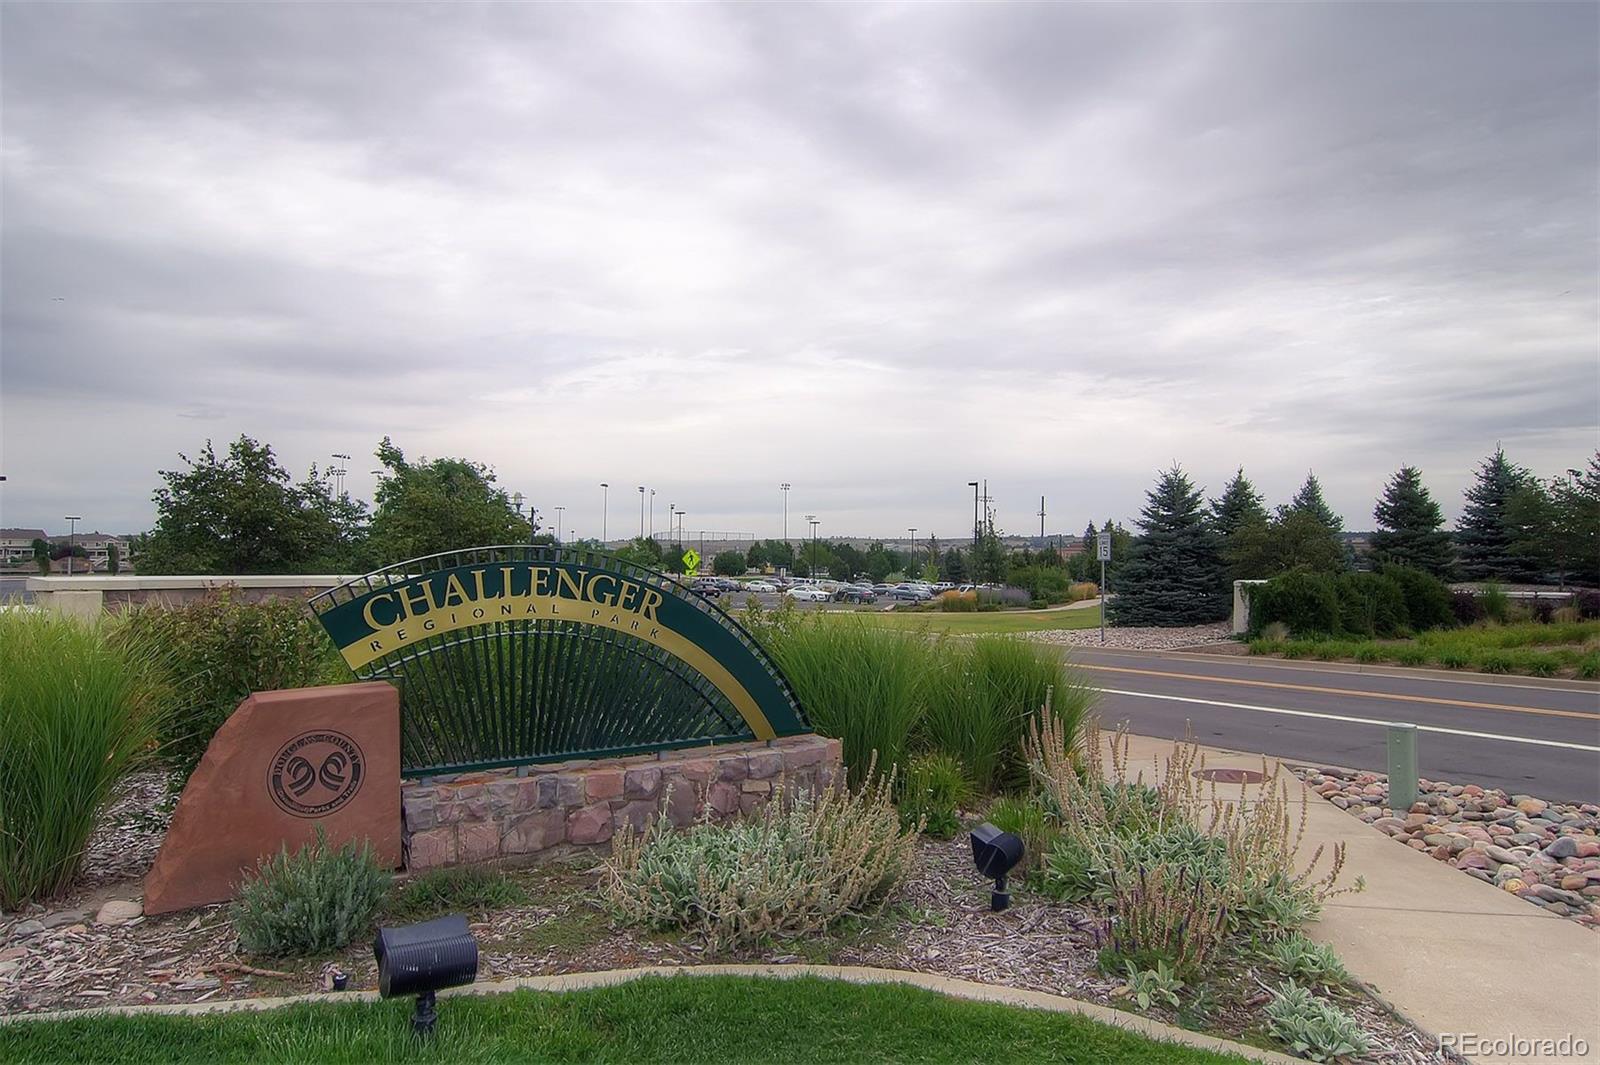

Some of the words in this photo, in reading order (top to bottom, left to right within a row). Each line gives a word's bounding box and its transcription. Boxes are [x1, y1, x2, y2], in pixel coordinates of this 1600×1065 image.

[1099, 546, 1108, 557] 15
[362, 566, 664, 632] CHALLENGER
[370, 603, 560, 653] REGIONAL
[591, 607, 661, 640] PARK
[324, 734, 360, 764] COUNTY
